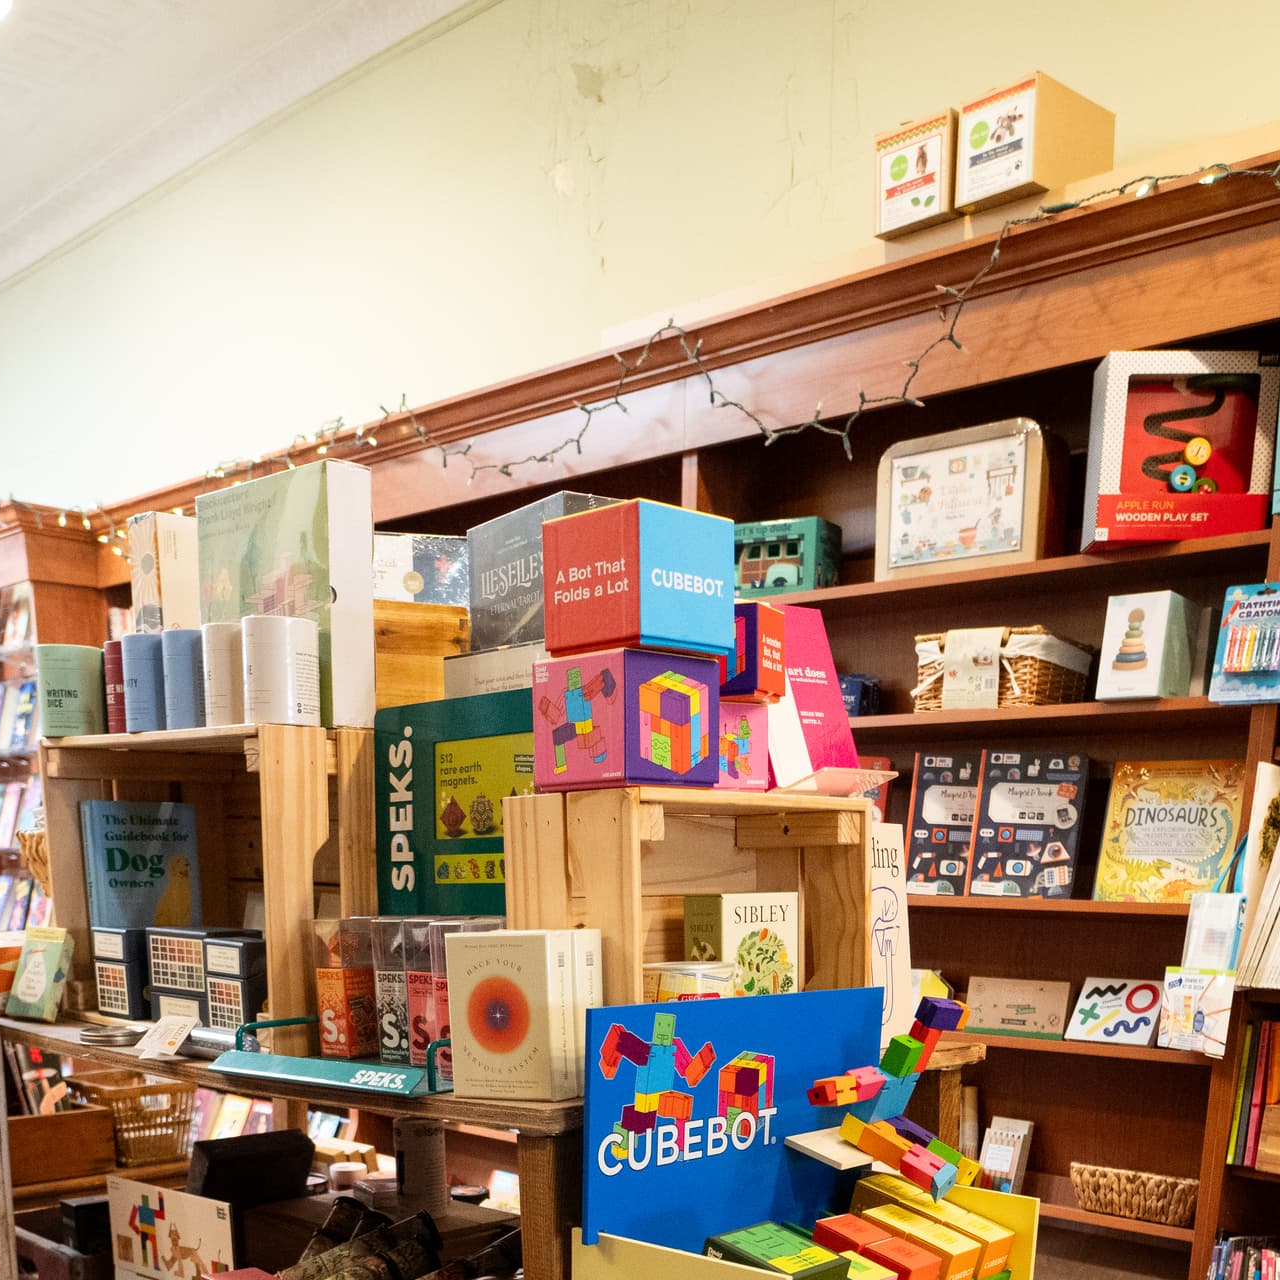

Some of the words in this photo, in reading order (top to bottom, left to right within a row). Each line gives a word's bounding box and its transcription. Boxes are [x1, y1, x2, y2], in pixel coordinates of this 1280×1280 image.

[1117, 501, 1145, 510] APPLE
[1149, 501, 1174, 510] RUN
[1115, 513, 1161, 522] WOODEN
[1163, 513, 1188, 522] PLAY
[1190, 513, 1208, 522] SET
[555, 570, 566, 584] A
[569, 565, 592, 582] Bot
[594, 559, 626, 577] That
[651, 568, 724, 597] CUBEBOT
[554, 588, 590, 605] Folds
[594, 586, 603, 597] a
[607, 577, 629, 594] Lot
[788, 667, 803, 677] art
[805, 667, 826, 679] does
[46, 689, 78, 699] WRITING
[47, 699, 63, 709] DICE
[440, 753, 453, 763] 512
[440, 765, 457, 773] rare
[459, 762, 482, 773] earth
[440, 776, 478, 789] magnets.
[388, 726, 416, 892] SPEKS.
[103, 815, 127, 825] The
[129, 815, 179, 826] Ultimate
[1125, 807, 1218, 828] DINOSAURS
[104, 831, 170, 842] Guidebook
[172, 831, 189, 841] for
[105, 847, 165, 878] Dog
[108, 878, 154, 888] Owners
[734, 904, 790, 924] SIBLEY
[690, 924, 714, 932] SIBLEY
[466, 960, 491, 977] HACK
[495, 959, 523, 972] YOUR
[377, 973, 405, 983] SPEKS.
[322, 1009, 346, 1043] S.
[381, 1013, 409, 1048] S.
[463, 1045, 502, 1074] NERVOUS
[508, 1046, 540, 1073] SYSTEM
[351, 1069, 404, 1089] SPEKS.
[984, 1255, 1008, 1271] CUBEBOT
